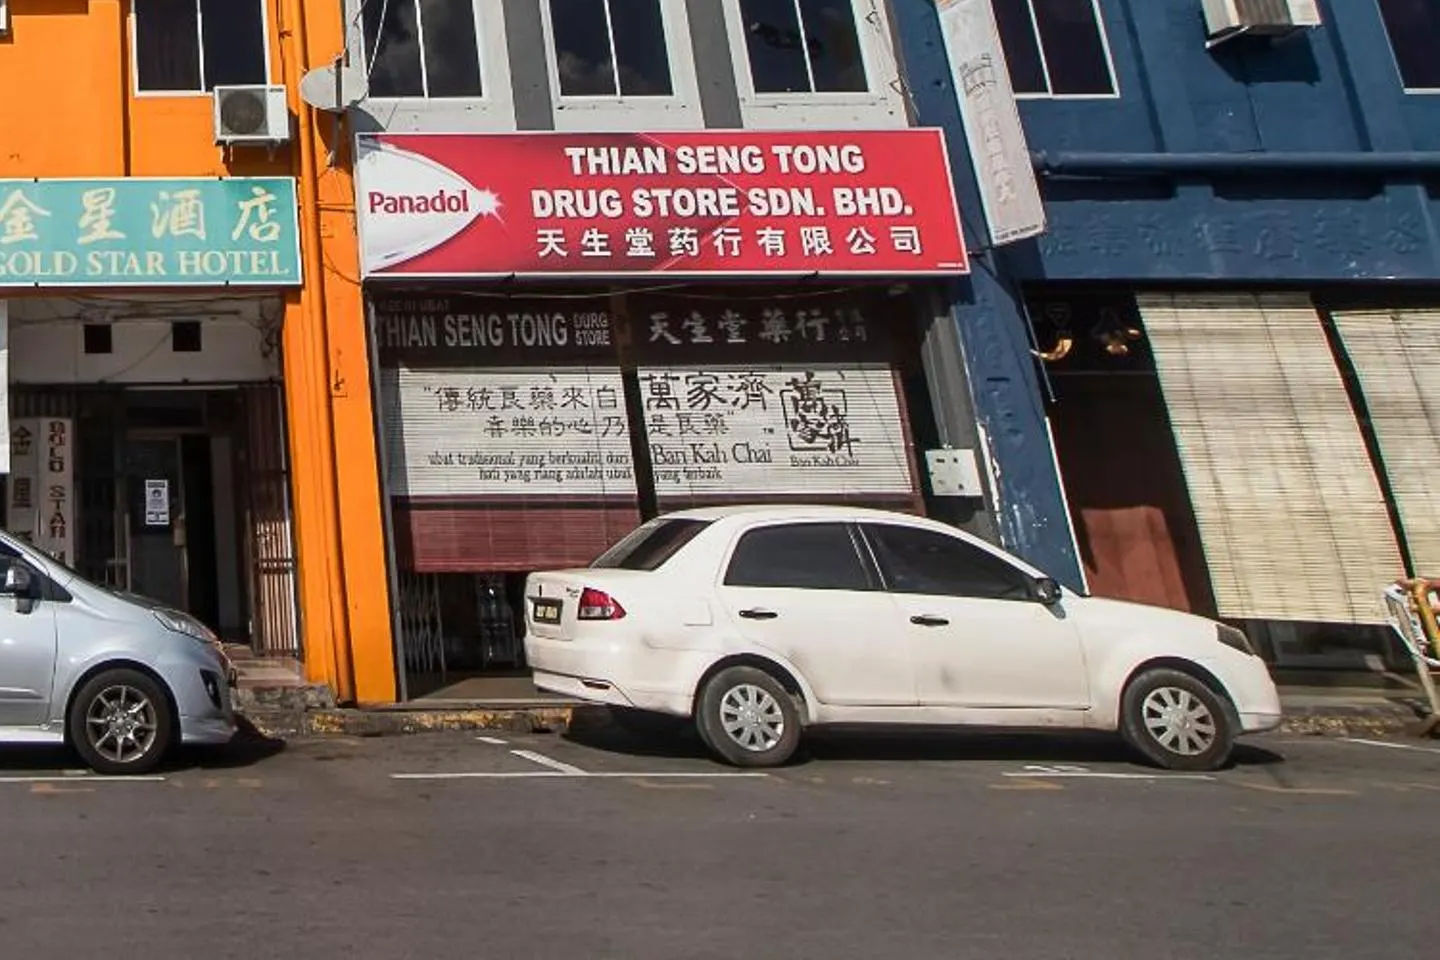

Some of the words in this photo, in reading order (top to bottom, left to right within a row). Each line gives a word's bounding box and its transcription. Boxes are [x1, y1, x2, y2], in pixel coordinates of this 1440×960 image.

[564, 146, 668, 176] THIAN
[675, 145, 766, 175] SENG
[772, 145, 866, 174] TONG
[368, 189, 471, 215] Panadol
[531, 188, 624, 218] DRUG
[632, 188, 741, 218] STORE
[747, 187, 827, 216] SDN.
[832, 187, 914, 216] BHD.
[536, 226, 923, 257] 天生堂药行有限公司
[86, 251, 168, 277] STAR
[176, 250, 291, 277] HOTEL
[444, 313, 504, 347] SENG
[507, 312, 568, 347] TONG
[652, 443, 687, 465] Ban
[690, 443, 728, 465] Kah
[731, 442, 773, 464] Chai
